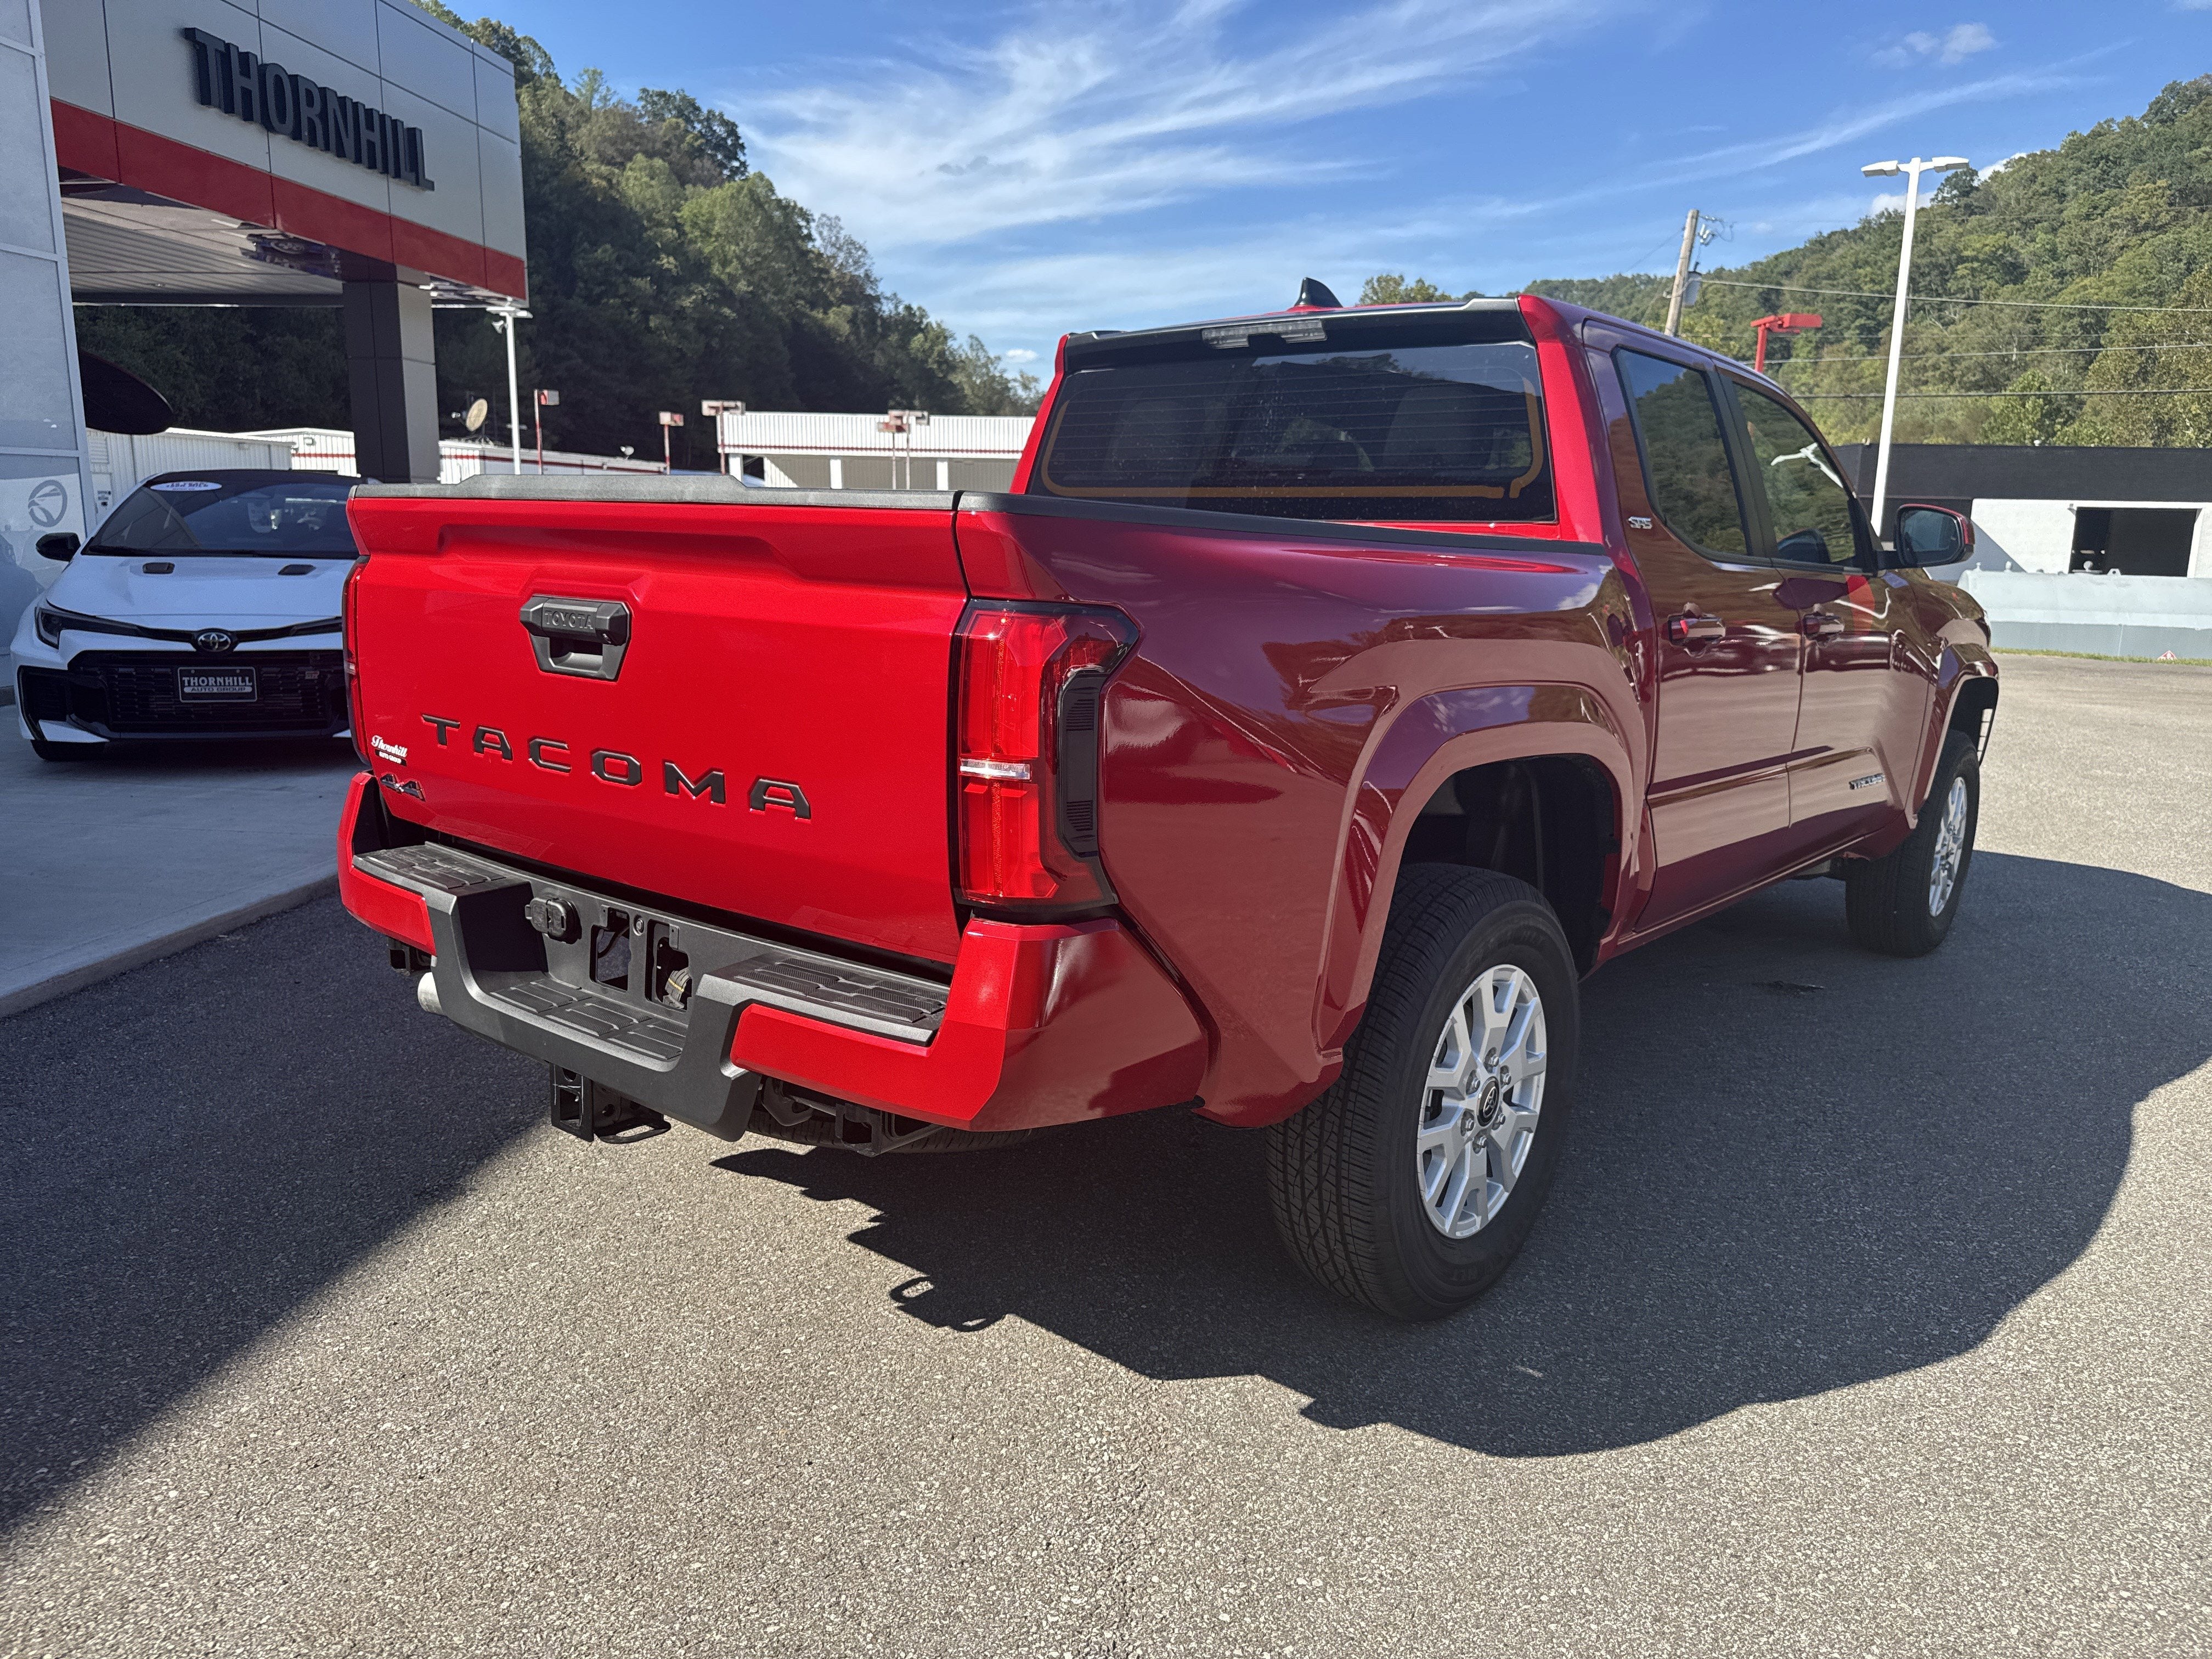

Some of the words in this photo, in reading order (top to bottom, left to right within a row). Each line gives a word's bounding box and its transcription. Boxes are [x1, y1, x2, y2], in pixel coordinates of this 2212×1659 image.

[184, 27, 435, 191] THORNHILL
[1628, 516, 1652, 529] SR5
[545, 610, 594, 630] TOYOTA
[182, 676, 252, 686] THORNHILL
[371, 735, 408, 758] Thornhill
[422, 714, 812, 820] TACOMA
